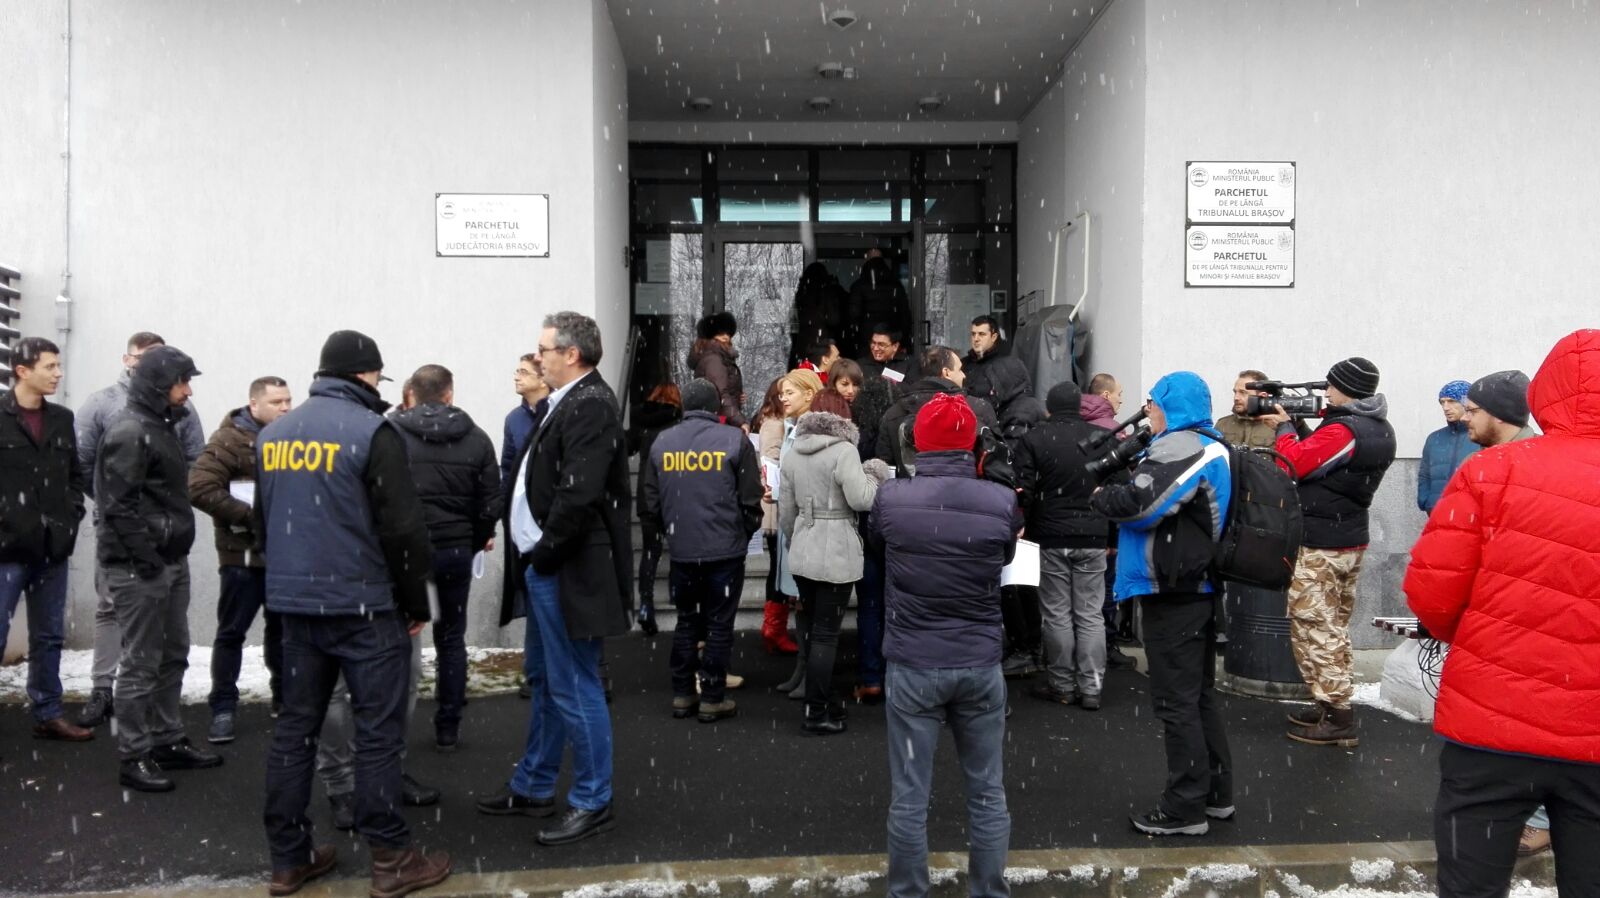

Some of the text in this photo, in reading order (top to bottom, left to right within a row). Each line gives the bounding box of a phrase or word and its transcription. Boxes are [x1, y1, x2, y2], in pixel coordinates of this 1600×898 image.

[1214, 188, 1269, 197] PARCHETUL
[1198, 209, 1250, 217] TRIBUNALUL
[465, 221, 520, 230] PARCHETUL
[1227, 231, 1259, 239] ROMÂNIA
[1213, 252, 1268, 260] PARCHETUL
[262, 440, 341, 473] DIICOT
[663, 450, 727, 472] DIICOT
